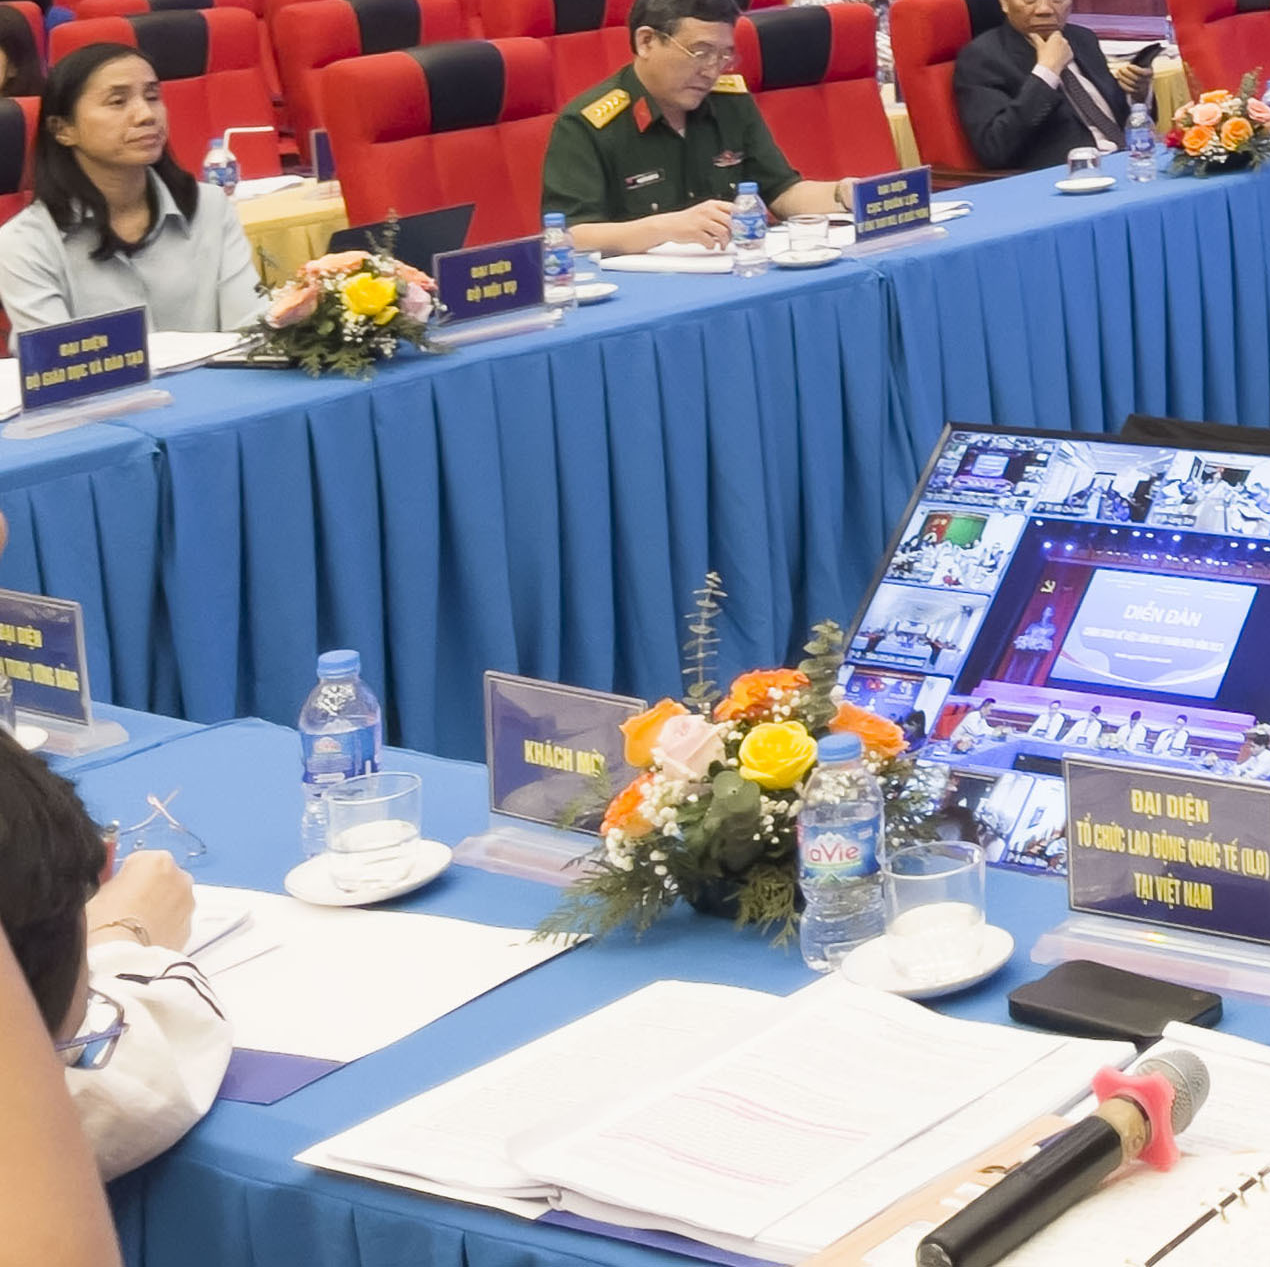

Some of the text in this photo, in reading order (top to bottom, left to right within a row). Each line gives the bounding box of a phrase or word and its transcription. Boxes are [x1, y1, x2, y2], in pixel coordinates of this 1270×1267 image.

[524, 739, 606, 778] KHÁCH MỜ
[1130, 788, 1210, 827] ĐẠI DIỆN
[1076, 813, 1270, 878] TỔ CHỨC LAO ĐỘNG QUỐC TẾ (ILO)
[1133, 872, 1213, 911] TẠI VIỆT NAM
